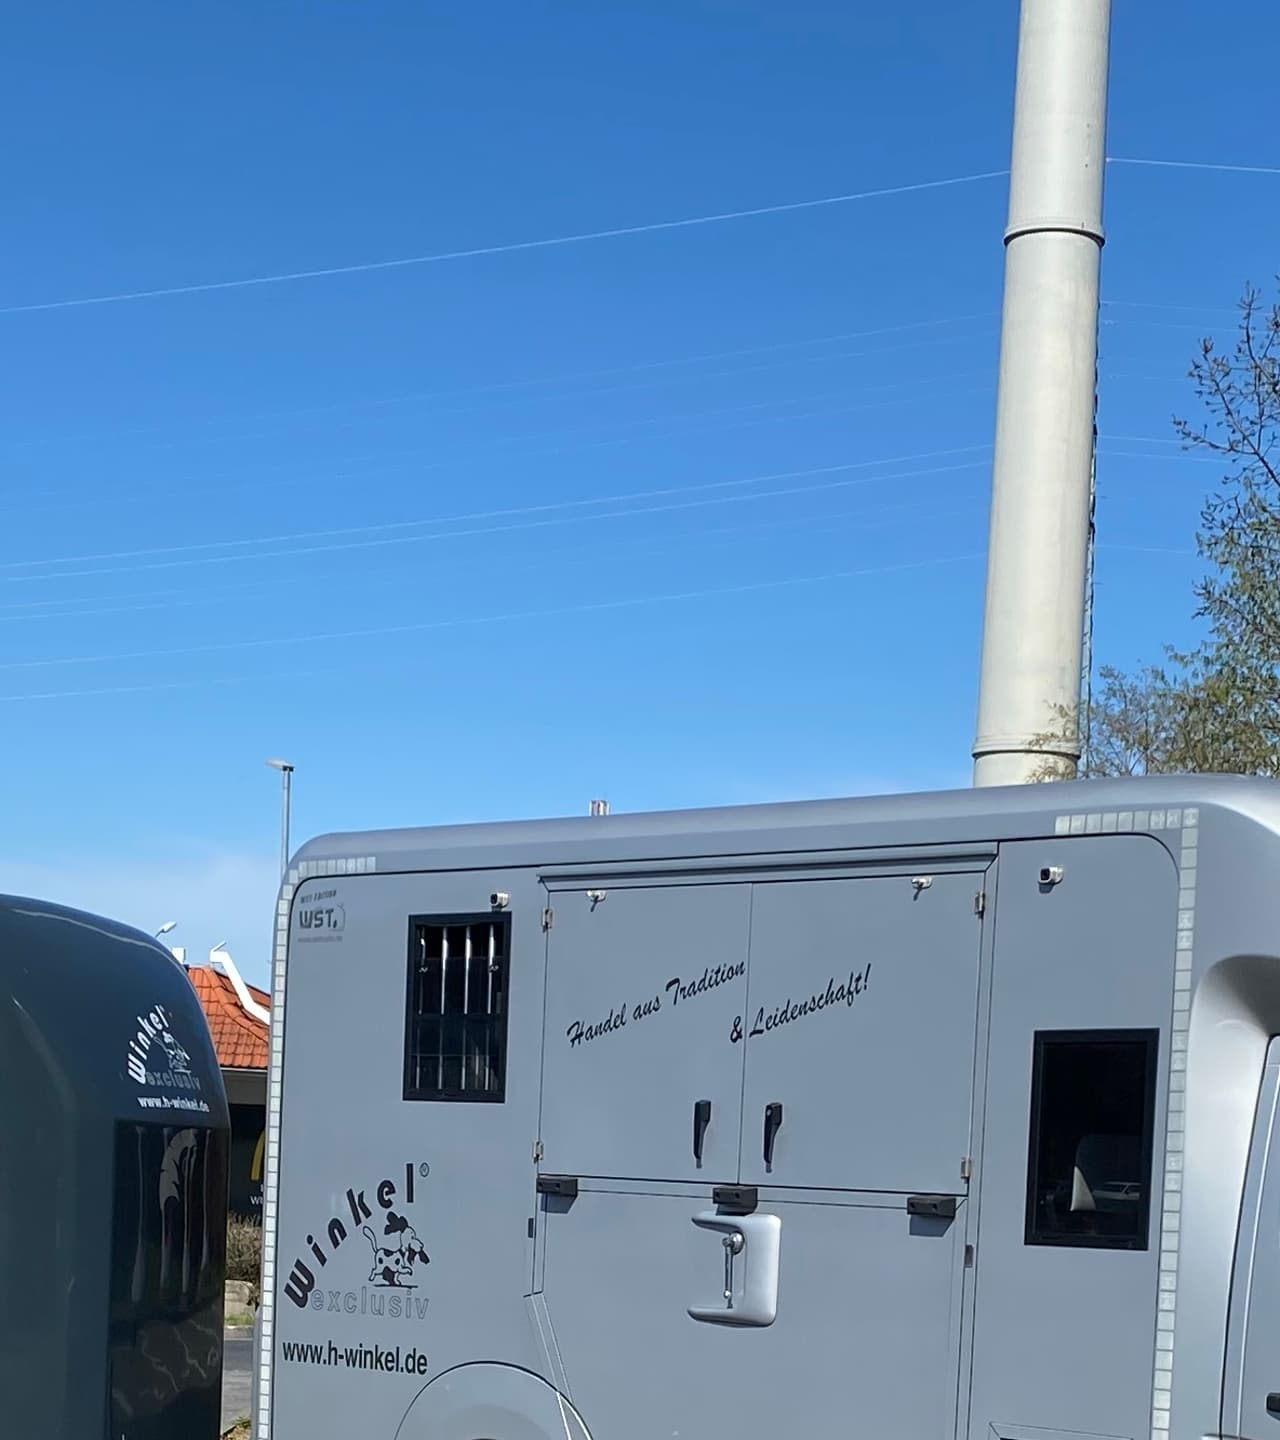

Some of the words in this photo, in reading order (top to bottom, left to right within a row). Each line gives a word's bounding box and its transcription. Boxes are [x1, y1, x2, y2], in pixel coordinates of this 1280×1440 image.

[566, 1002, 627, 1048] Handel
[632, 995, 662, 1021] aus
[665, 960, 746, 1006] Tradition
[730, 1015, 744, 1044] &
[748, 963, 872, 1038] Leidenschaft!
[283, 1163, 415, 1309] Winkel
[311, 1286, 430, 1320] exclusiv
[282, 1340, 428, 1375] www.h-winkel.de
